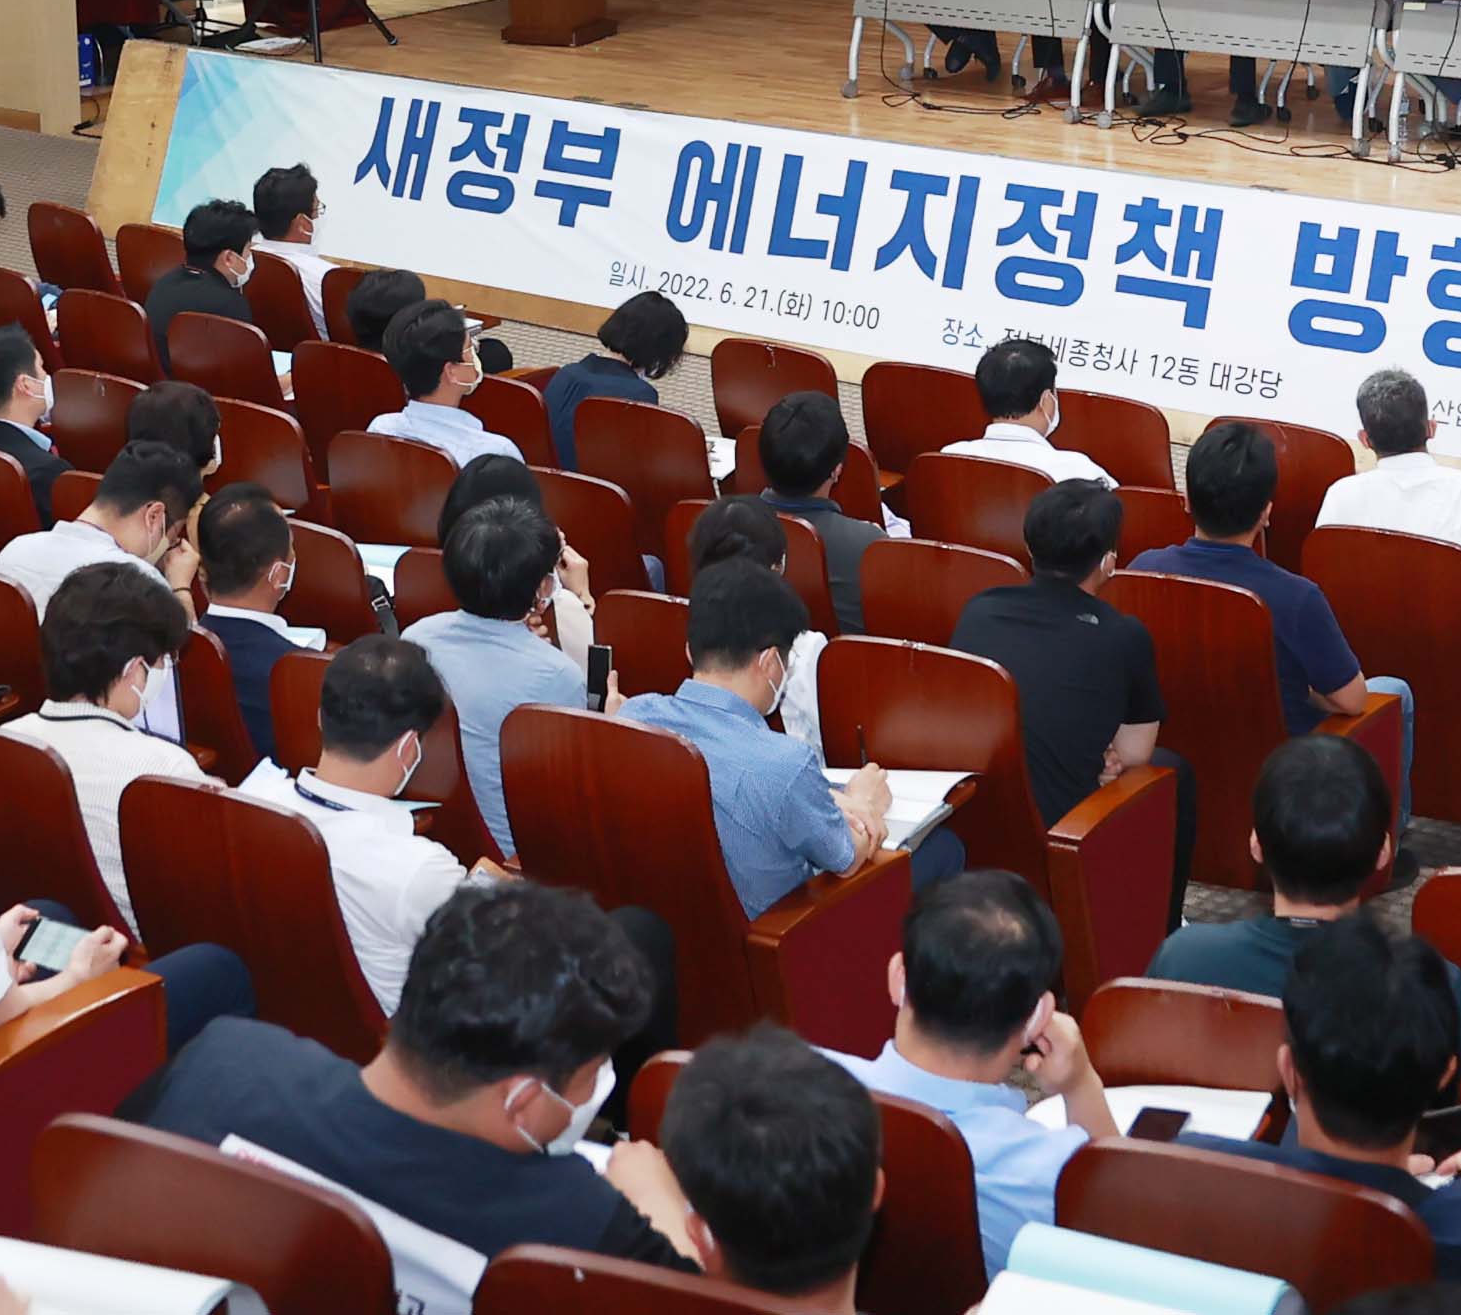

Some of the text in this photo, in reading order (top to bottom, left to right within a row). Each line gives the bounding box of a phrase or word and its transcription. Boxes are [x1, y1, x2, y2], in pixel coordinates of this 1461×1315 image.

[354, 95, 622, 228] 새정부
[665, 139, 1224, 330] 에너지정책
[608, 260, 650, 291] 일시.
[657, 270, 713, 302] 2022.
[719, 281, 737, 306] 6.
[743, 285, 813, 321] 21.(화)
[821, 298, 881, 330] 10:00
[1148, 353, 1200, 387] 12동
[1208, 360, 1283, 400] 대강당
